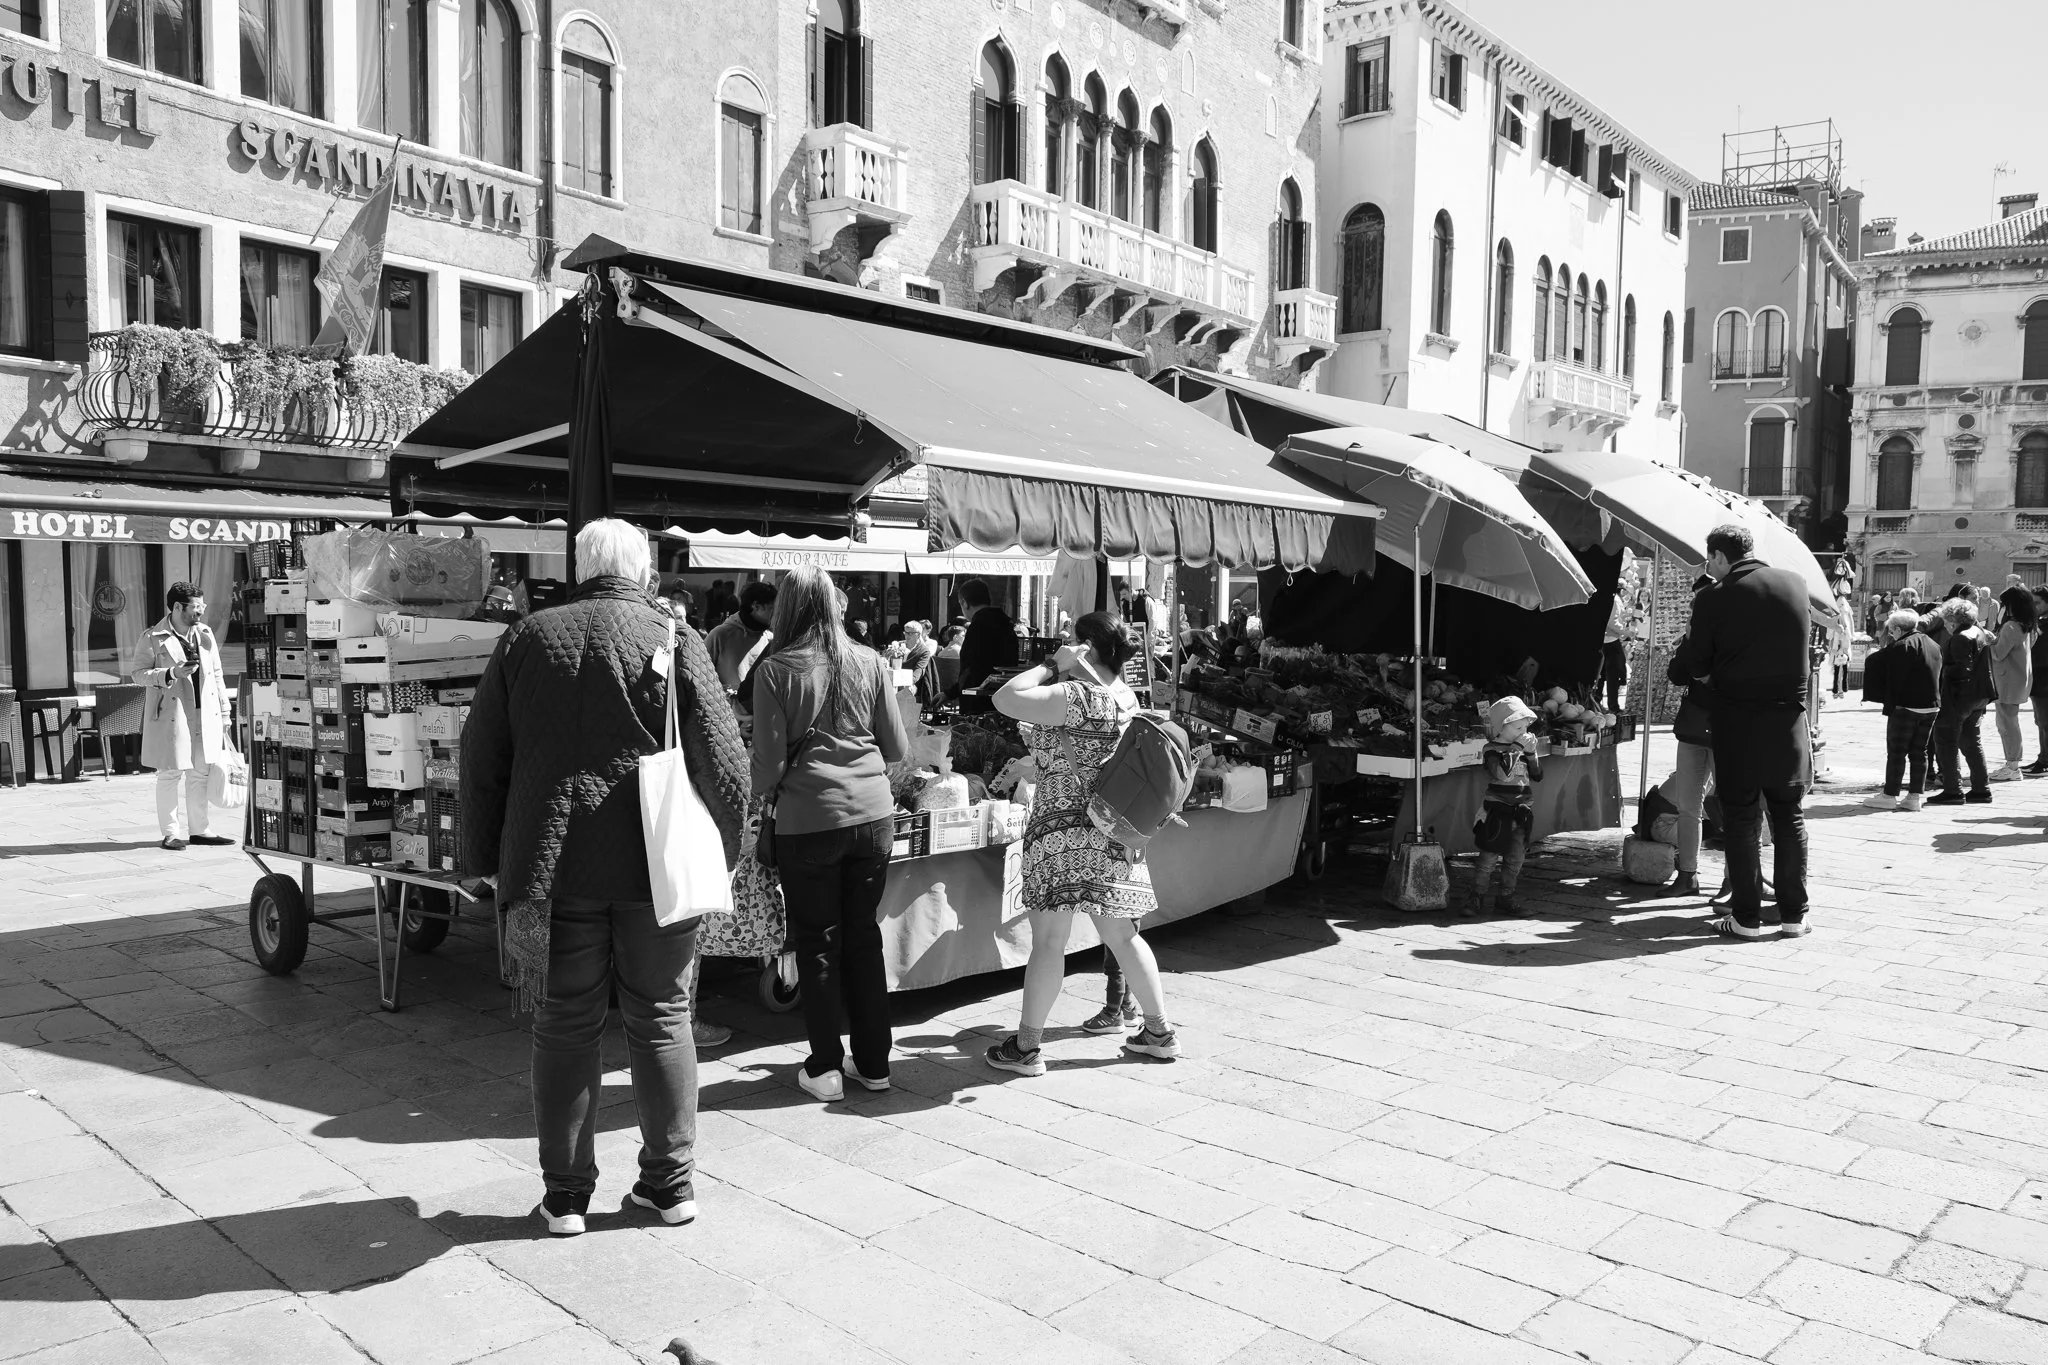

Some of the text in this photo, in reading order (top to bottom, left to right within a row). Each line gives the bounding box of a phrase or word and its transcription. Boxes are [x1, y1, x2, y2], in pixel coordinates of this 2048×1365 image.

[0, 54, 161, 136] OTEL
[11, 511, 134, 539] HOTEL
[762, 551, 849, 567] RISTORANTE
[953, 559, 991, 572] CAMPO
[995, 560, 1028, 573] SANTA
